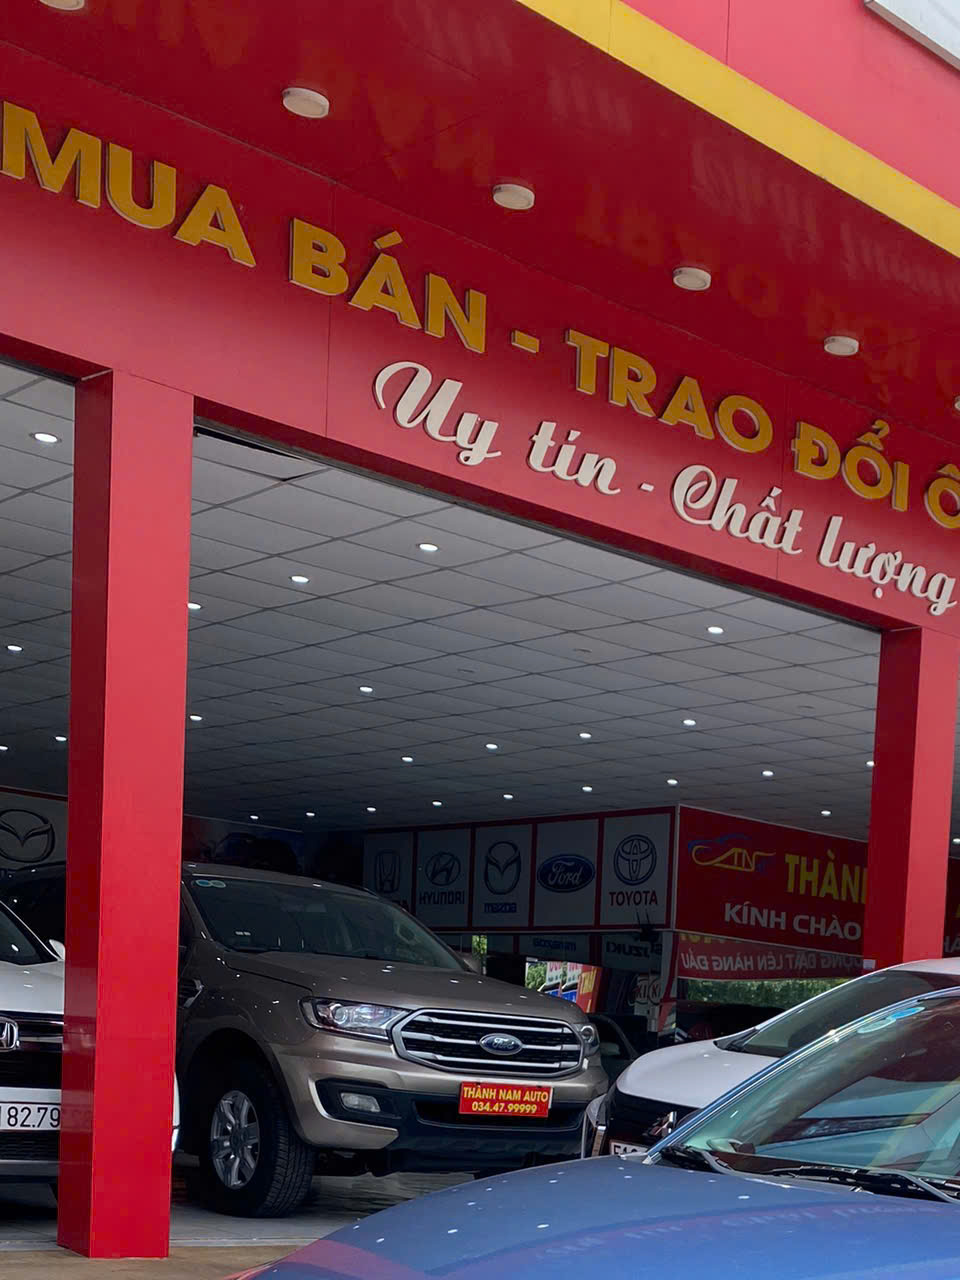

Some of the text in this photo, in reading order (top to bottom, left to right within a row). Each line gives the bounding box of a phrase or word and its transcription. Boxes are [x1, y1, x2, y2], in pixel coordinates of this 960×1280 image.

[0, 103, 256, 268] MUA
[289, 218, 487, 354] BÁN
[564, 328, 774, 455] TRAO
[791, 420, 910, 512] ĐỔI
[374, 360, 502, 467] Uy
[526, 421, 622, 496] tín
[671, 464, 804, 556] Chất
[817, 515, 959, 617] lượng
[419, 890, 466, 906] HYUNDAI
[608, 890, 658, 908] TOYOTA
[484, 902, 517, 914] mazda
[723, 901, 787, 931] KÍNH
[792, 913, 862, 942] CHÀO
[463, 1084, 549, 1103] THÀNH NAM AUTO
[471, 1101, 538, 1114] 034.47.99999
